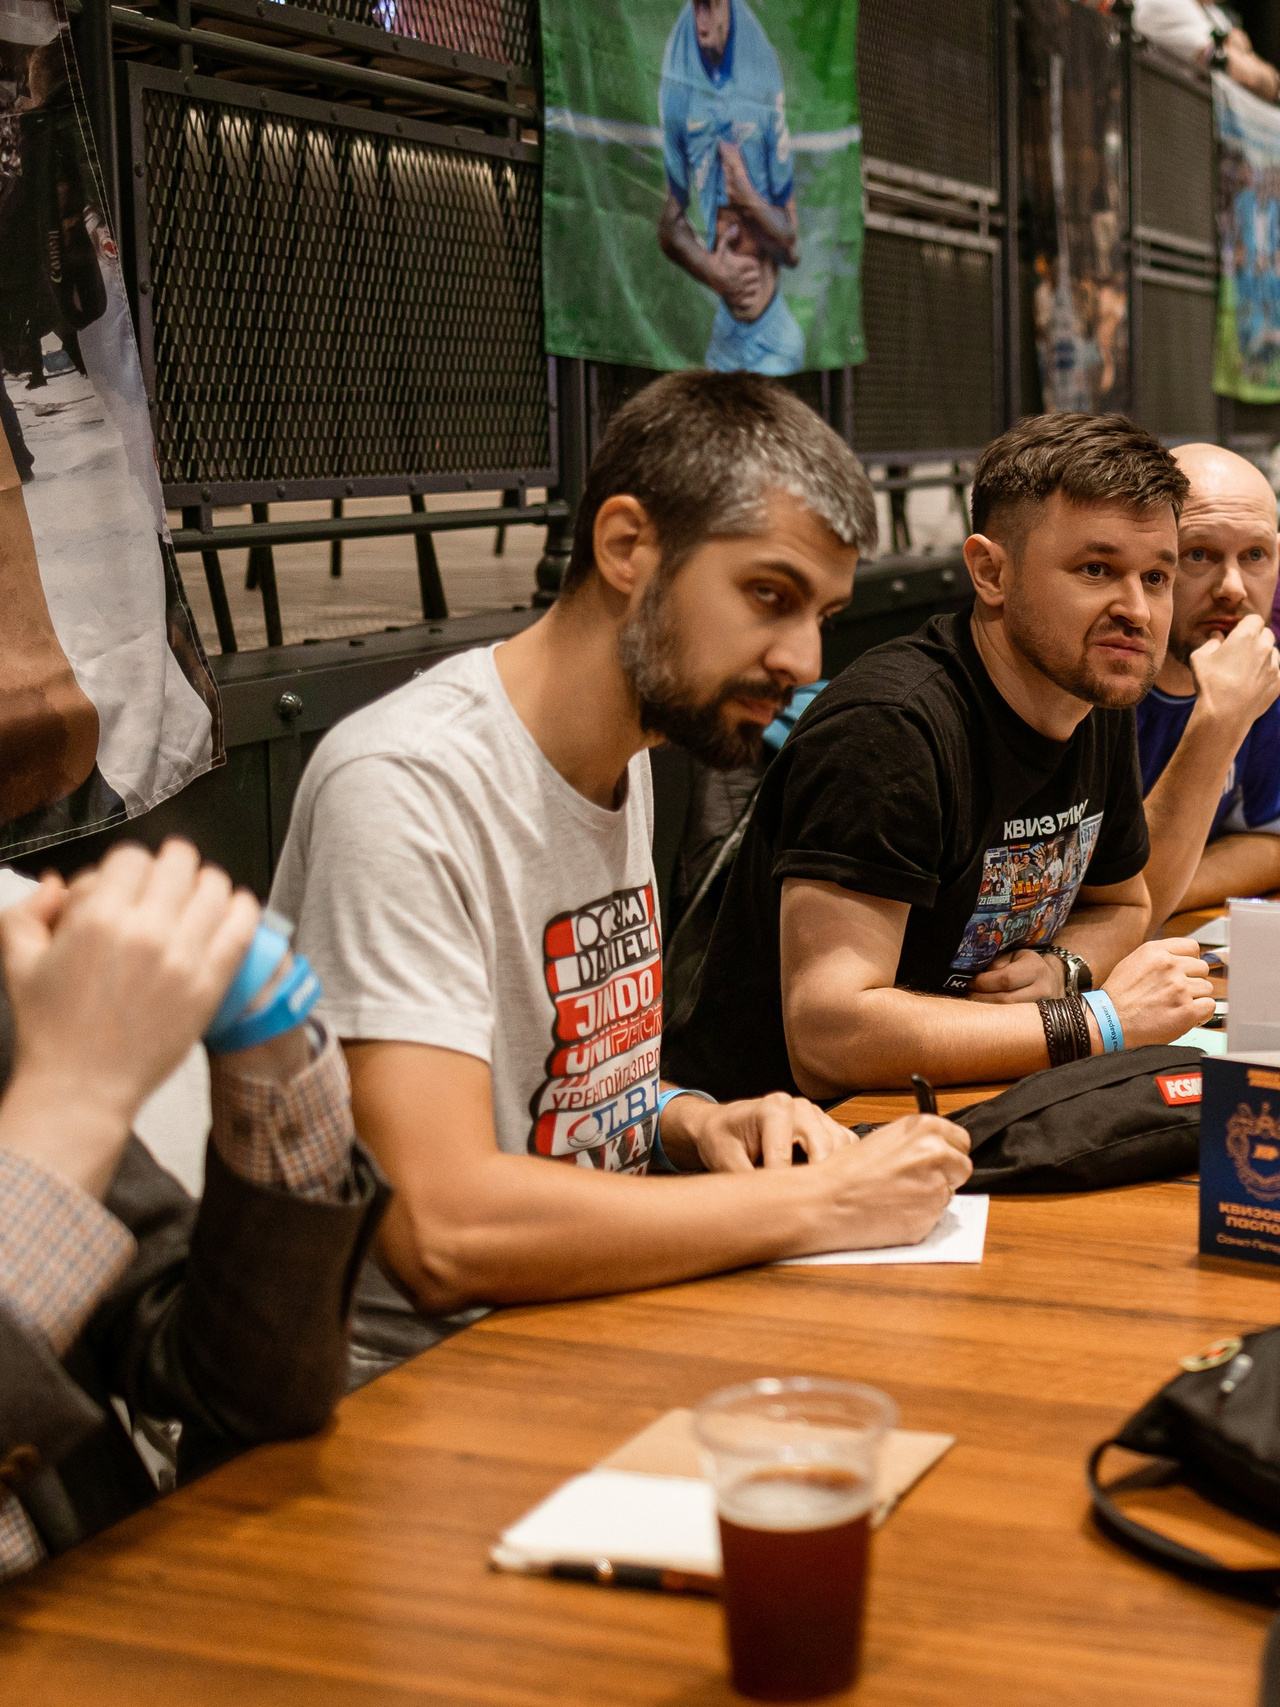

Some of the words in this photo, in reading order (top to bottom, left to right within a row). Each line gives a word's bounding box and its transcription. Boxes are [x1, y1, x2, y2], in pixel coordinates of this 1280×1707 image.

[1003, 815, 1057, 841] КВИЗ
[573, 968, 655, 1037] JINDO
[552, 1047, 660, 1110] УРЕНГОЙГАЗПРО
